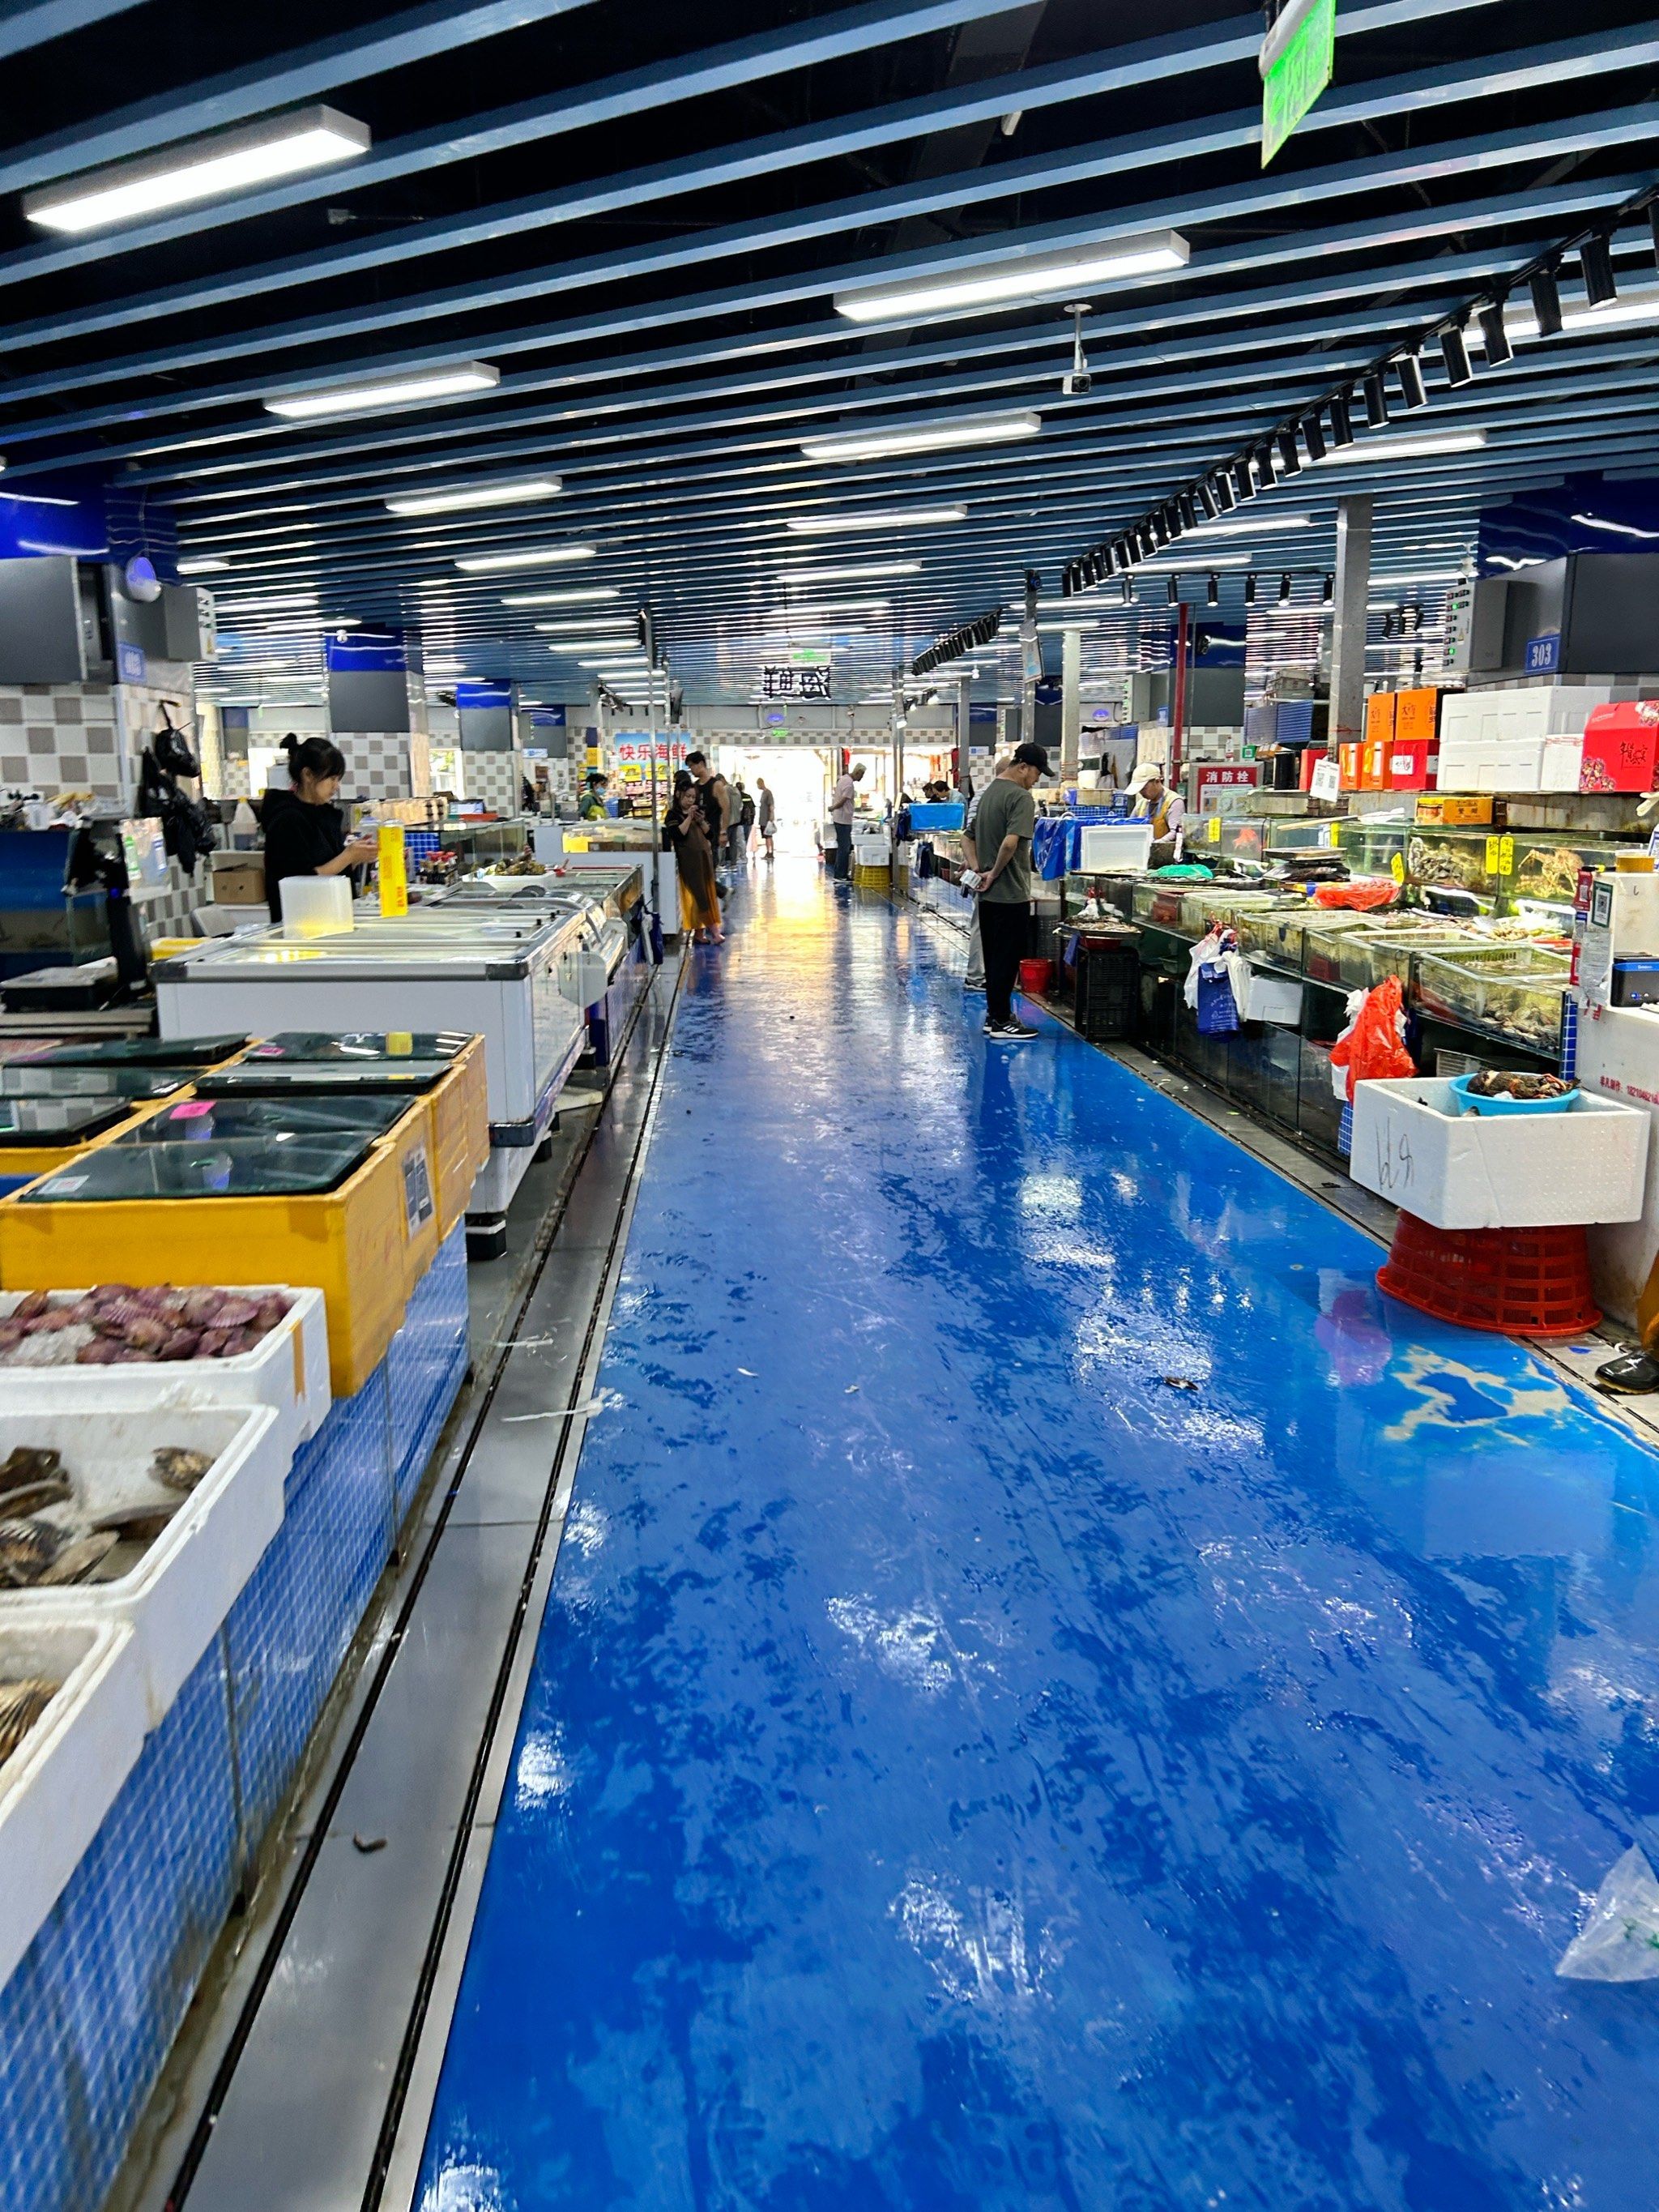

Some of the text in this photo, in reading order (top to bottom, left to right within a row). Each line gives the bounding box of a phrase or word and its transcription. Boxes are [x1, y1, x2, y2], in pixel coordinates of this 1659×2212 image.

[1531, 643, 1552, 668] 303
[619, 743, 688, 760] 快乐海鲜
[1205, 771, 1249, 783] 消防栓
